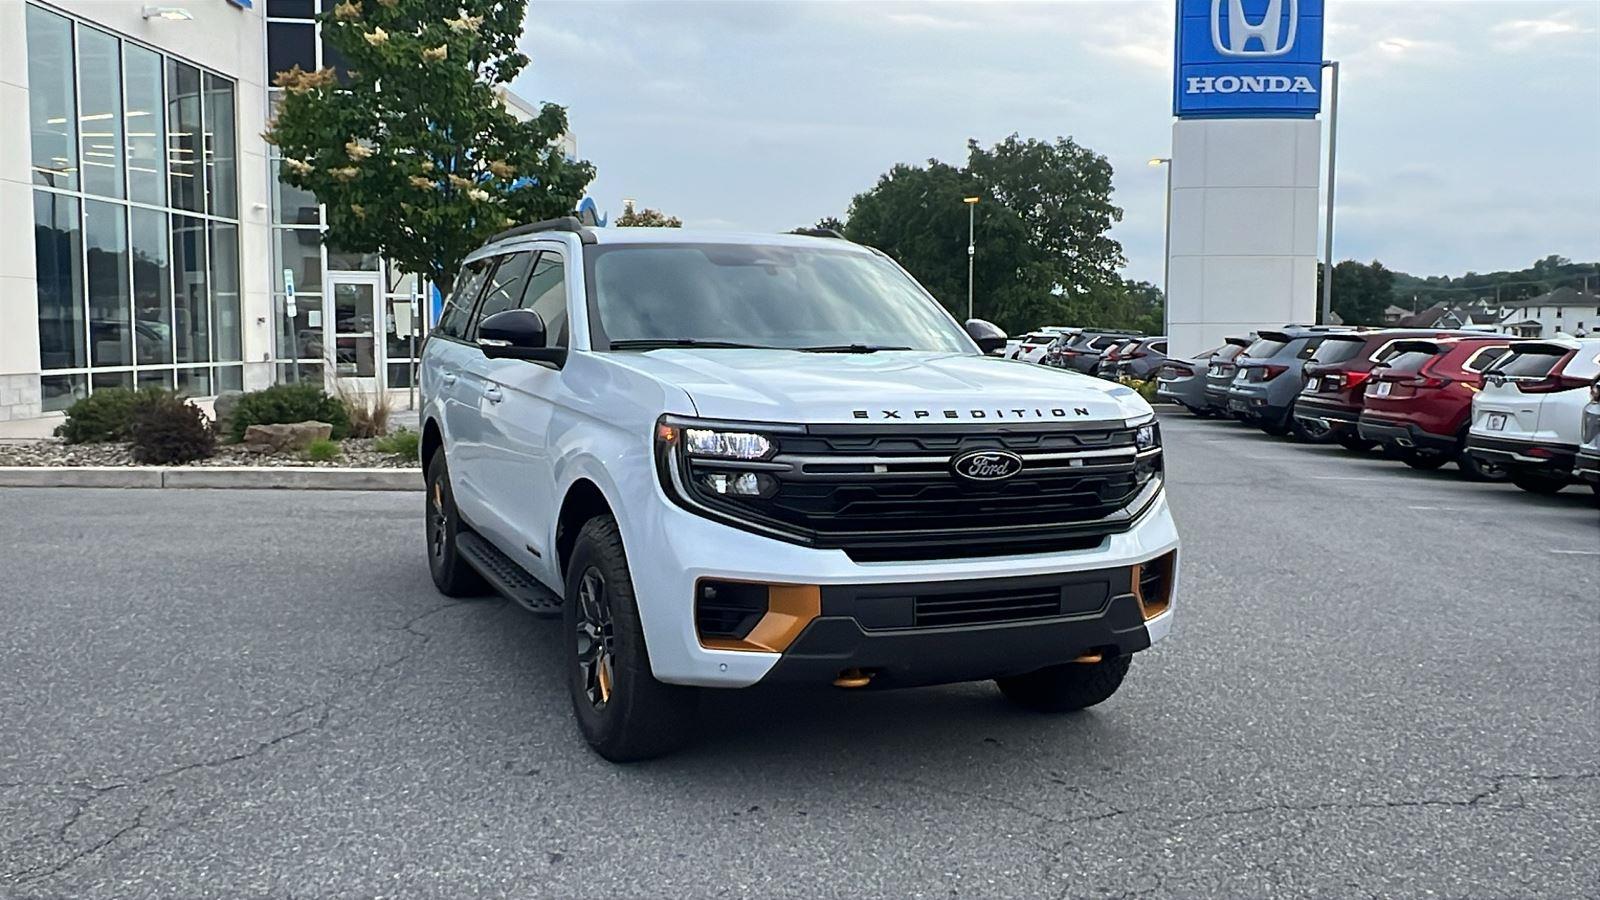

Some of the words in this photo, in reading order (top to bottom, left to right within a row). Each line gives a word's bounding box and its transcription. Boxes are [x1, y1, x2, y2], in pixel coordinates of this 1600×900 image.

[1186, 75, 1317, 94] HONDA
[852, 407, 1090, 419] EXPEDITION
[968, 455, 1010, 476] Ford
